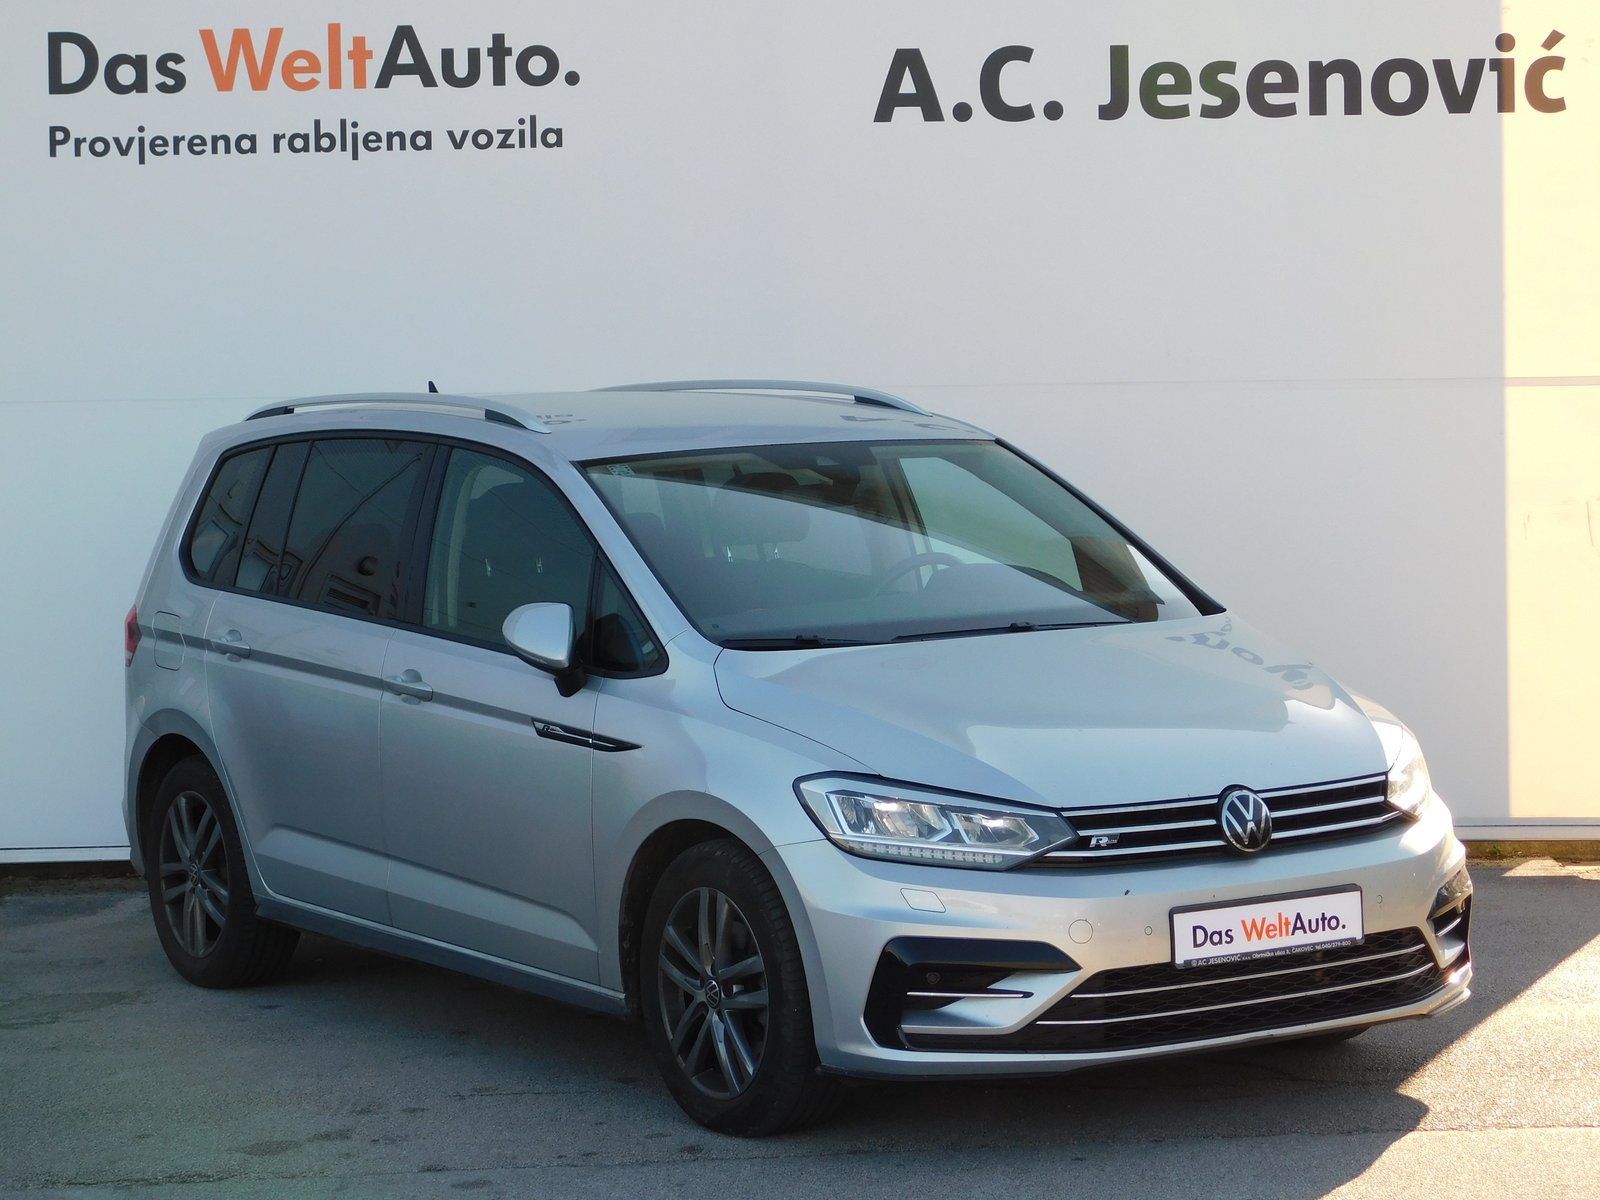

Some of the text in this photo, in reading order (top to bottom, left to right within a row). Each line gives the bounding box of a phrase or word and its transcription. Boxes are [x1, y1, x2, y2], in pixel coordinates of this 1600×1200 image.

[47, 22, 581, 96] Das WeltAuto.
[872, 28, 1567, 123] A.C. Jesenović
[48, 114, 564, 165] Provjerena rabljena vozila
[1192, 911, 1348, 949] Das WeltAuto.
